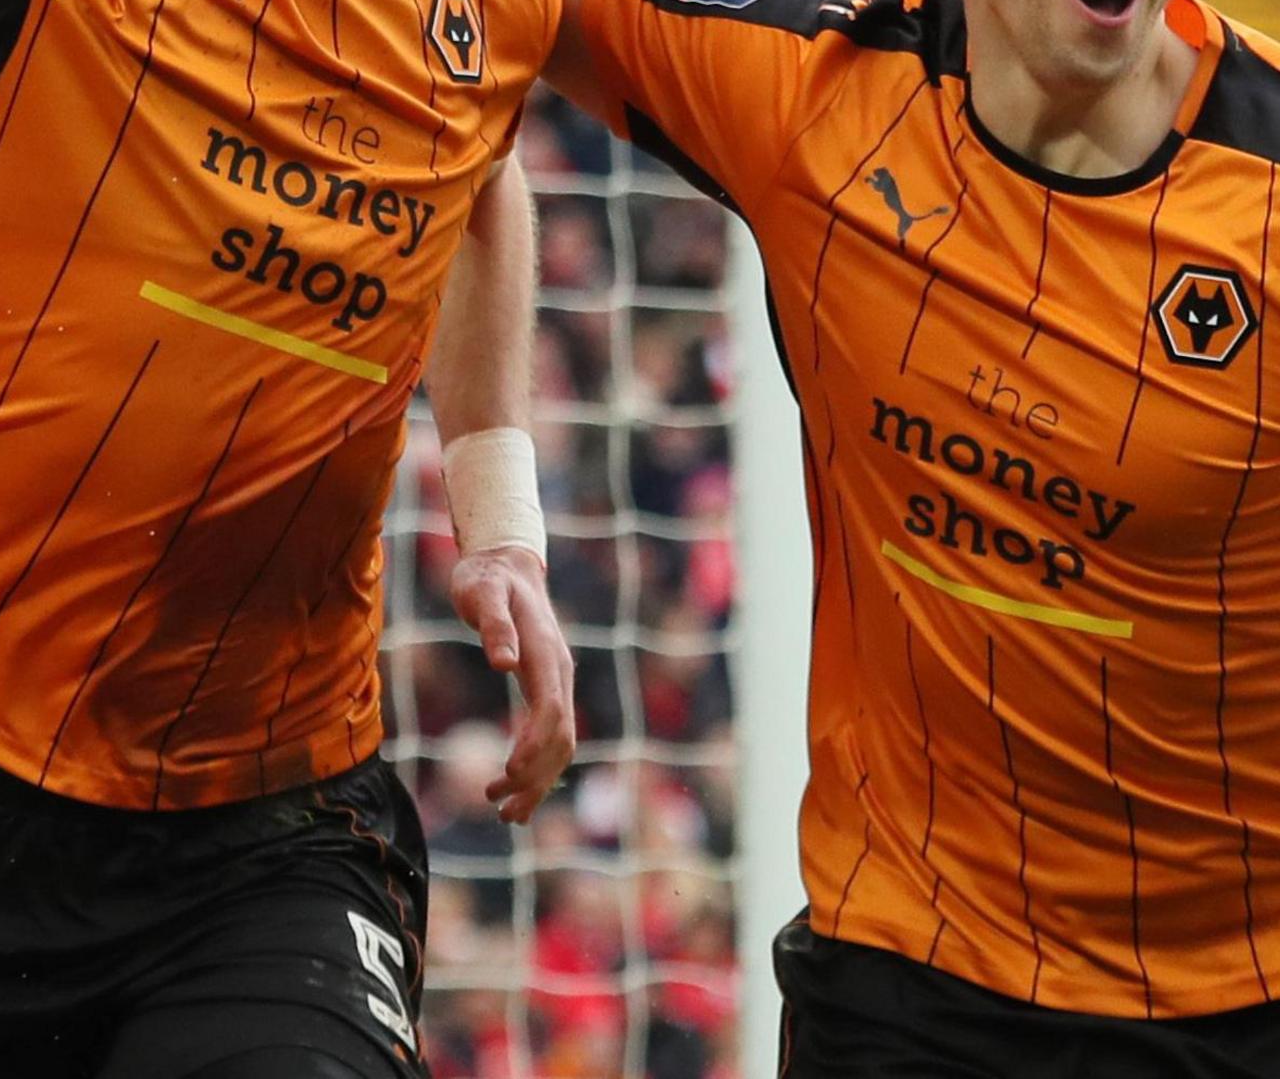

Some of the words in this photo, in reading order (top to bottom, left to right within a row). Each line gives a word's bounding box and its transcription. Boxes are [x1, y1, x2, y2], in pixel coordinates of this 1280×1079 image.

[300, 96, 381, 165] the
[200, 126, 436, 258] money
[211, 223, 388, 333] shop
[967, 364, 1059, 441] the
[870, 397, 1136, 542] money
[903, 490, 1086, 590] shop
[346, 910, 417, 1053] 5
